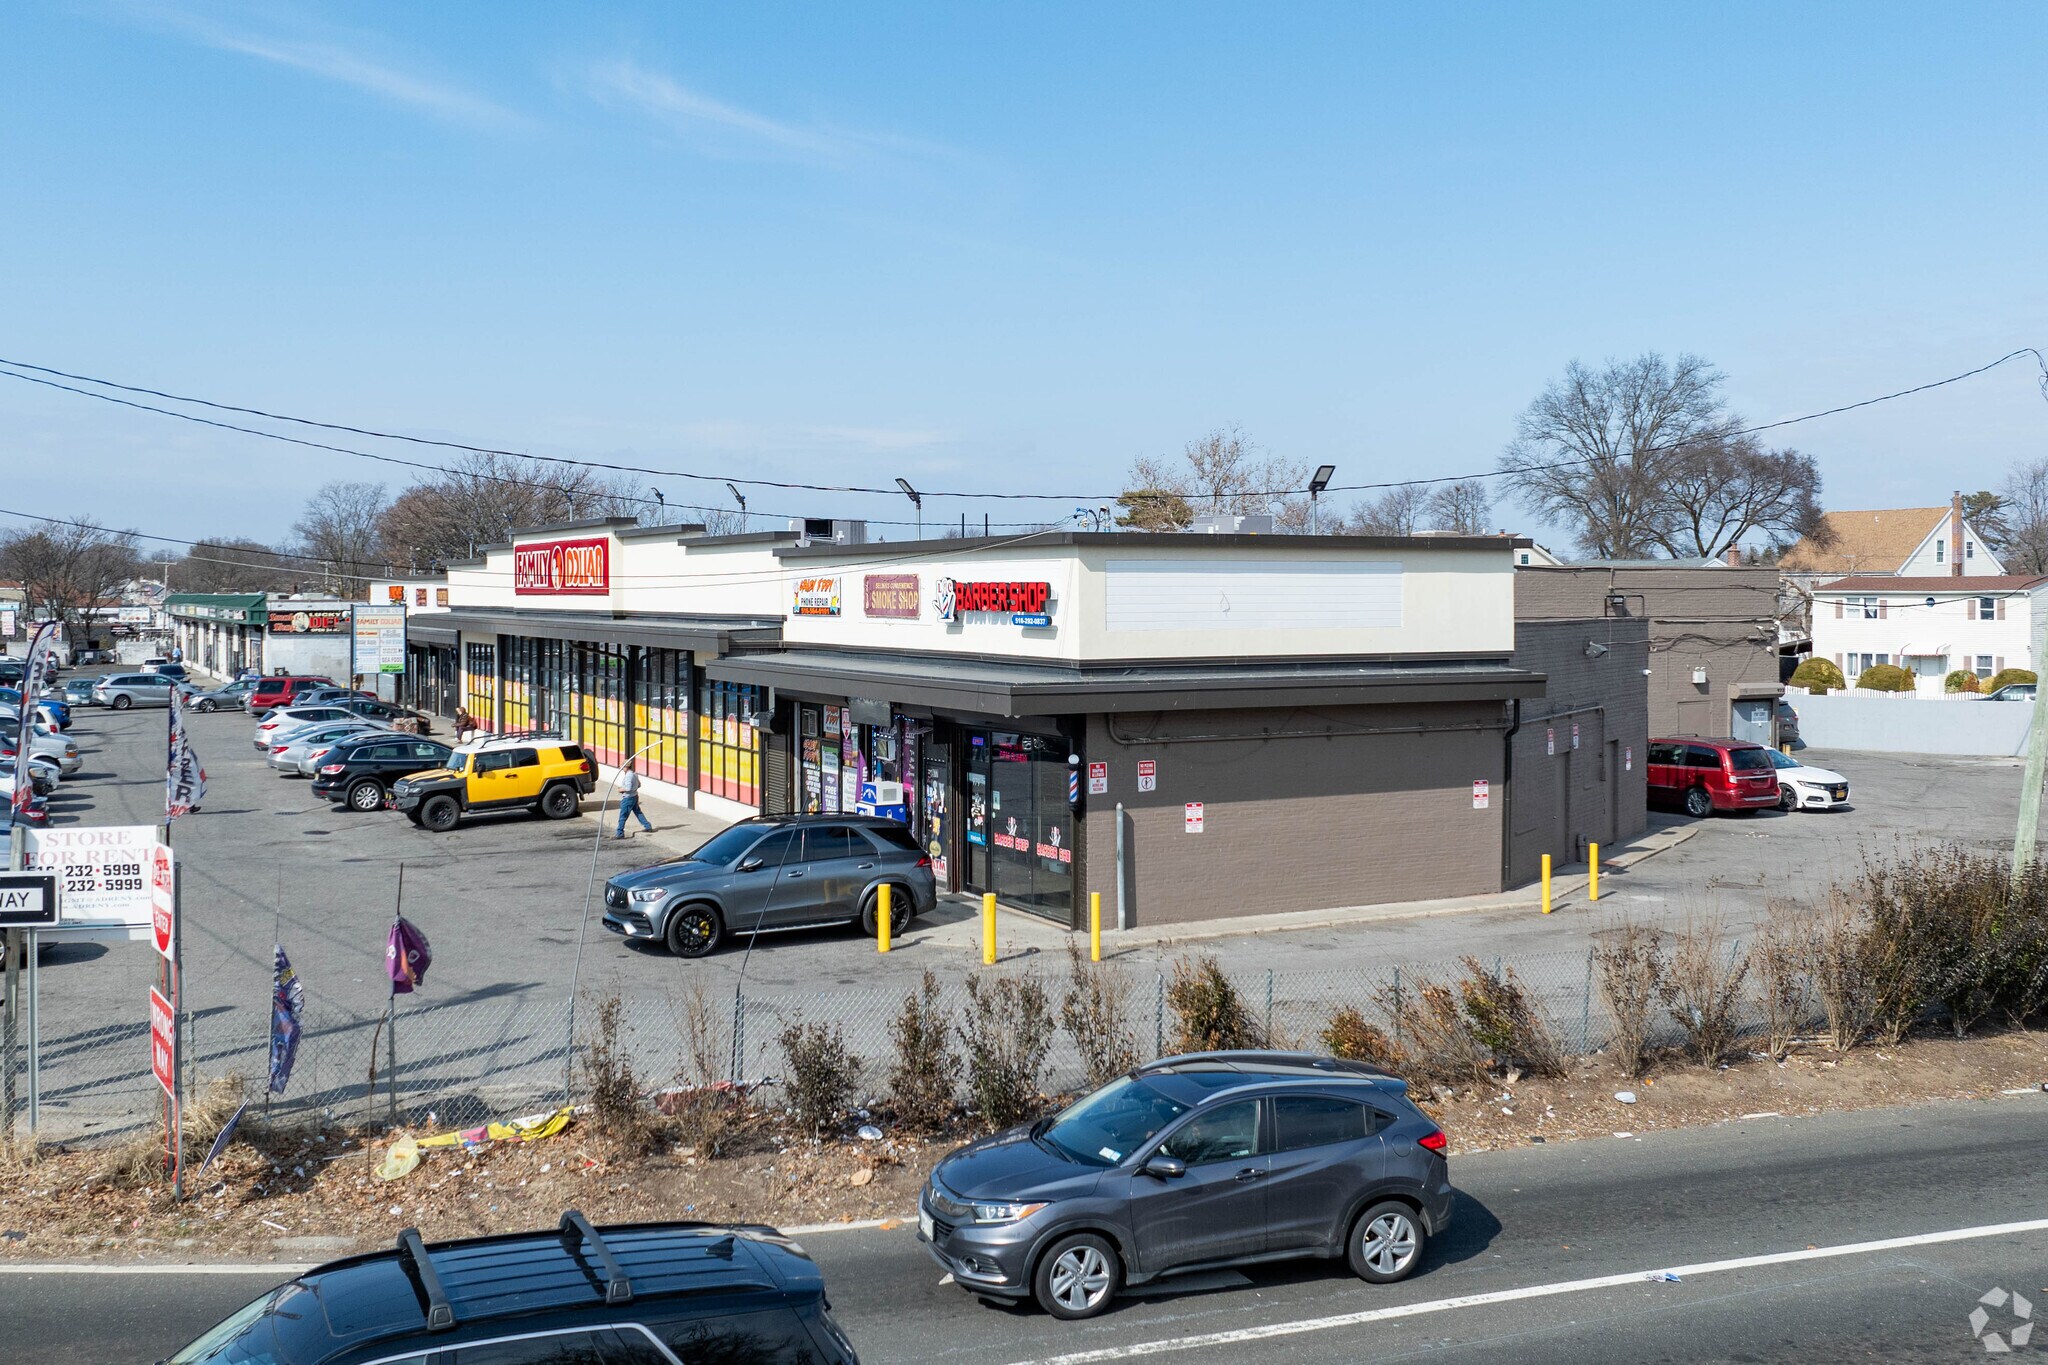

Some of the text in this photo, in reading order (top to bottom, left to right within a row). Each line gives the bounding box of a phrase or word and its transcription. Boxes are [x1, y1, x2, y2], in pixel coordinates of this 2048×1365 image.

[516, 545, 604, 588] FAMILY DOLLAR
[872, 590, 897, 608] SMOKE
[898, 590, 919, 610] SHOP
[955, 581, 1048, 612] BARBER SHOP
[825, 785, 837, 795] FREE
[825, 799, 837, 808] TALK
[46, 831, 132, 847] STORE
[24, 848, 151, 866] FOR RENT
[65, 865, 93, 877] 232
[103, 863, 140, 876] 5999
[67, 878, 142, 892] 232 5999
[0, 892, 30, 908] AY
[155, 910, 169, 935] ENTER
[152, 1001, 172, 1047] WRONG
[155, 1040, 168, 1078] WAY
